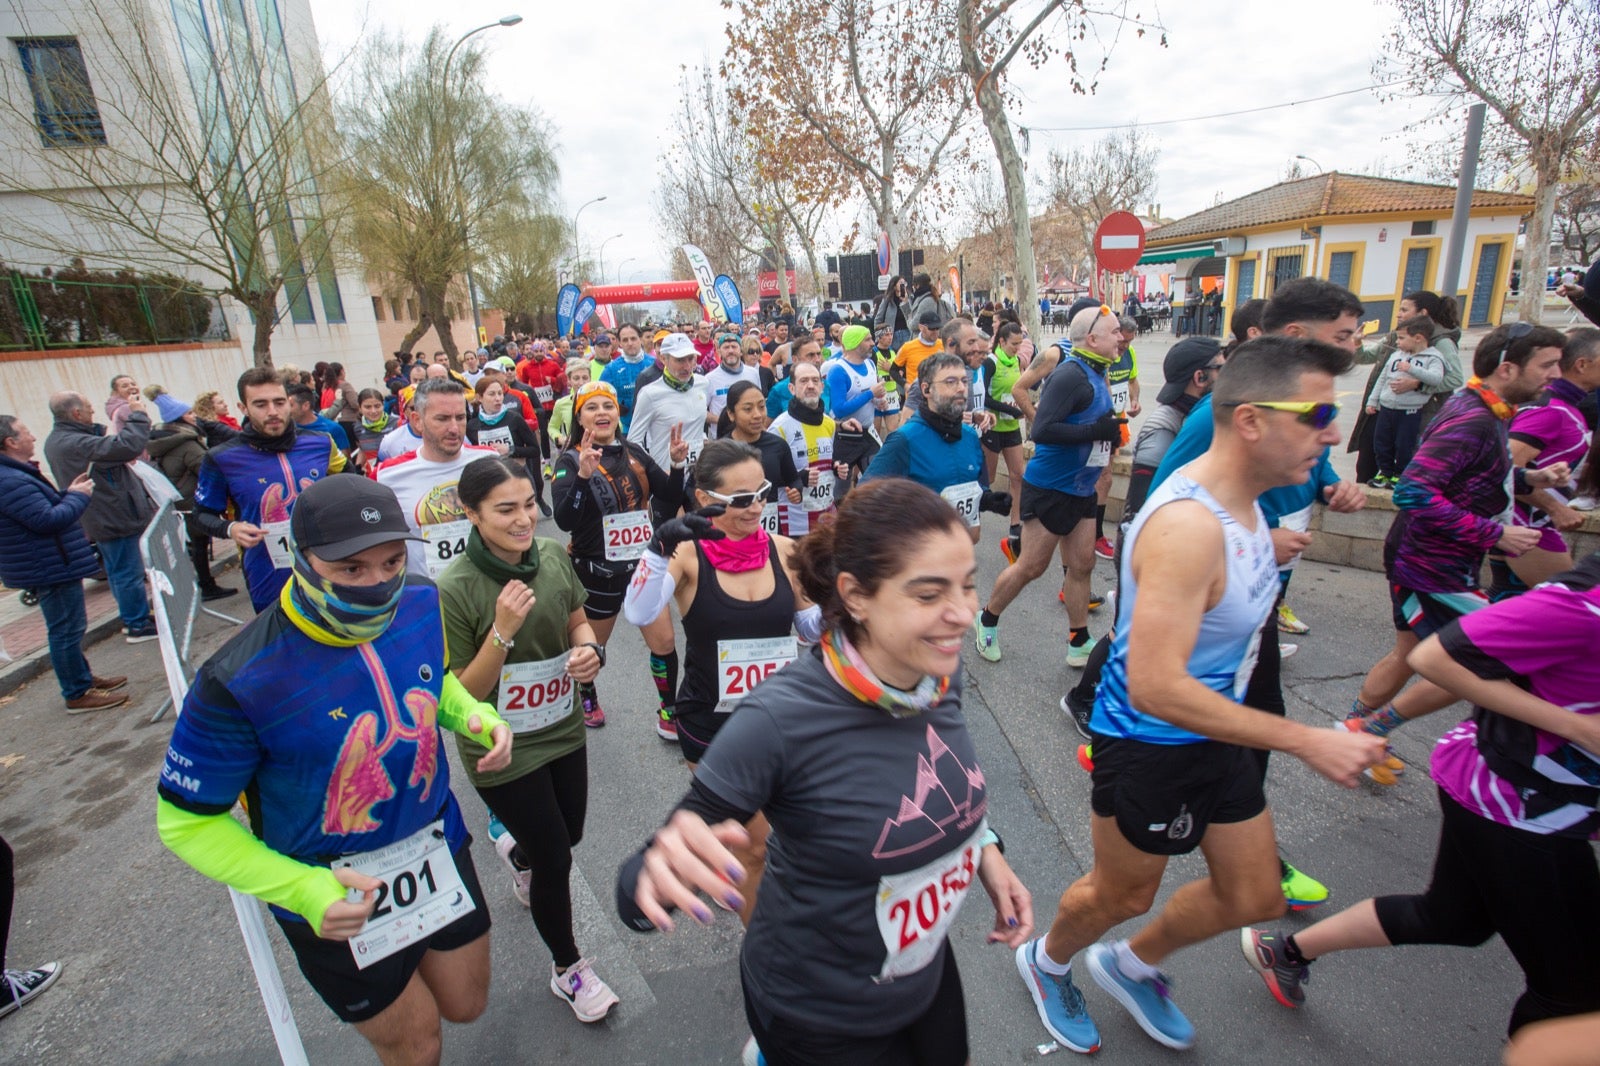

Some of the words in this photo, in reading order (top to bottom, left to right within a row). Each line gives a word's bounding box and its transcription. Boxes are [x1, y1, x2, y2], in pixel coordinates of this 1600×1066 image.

[760, 279, 776, 291] Coca
[809, 483, 831, 499] 405
[608, 525, 652, 547] 2026
[505, 672, 571, 710] 2098
[726, 661, 791, 695] 205
[368, 858, 437, 923] 201
